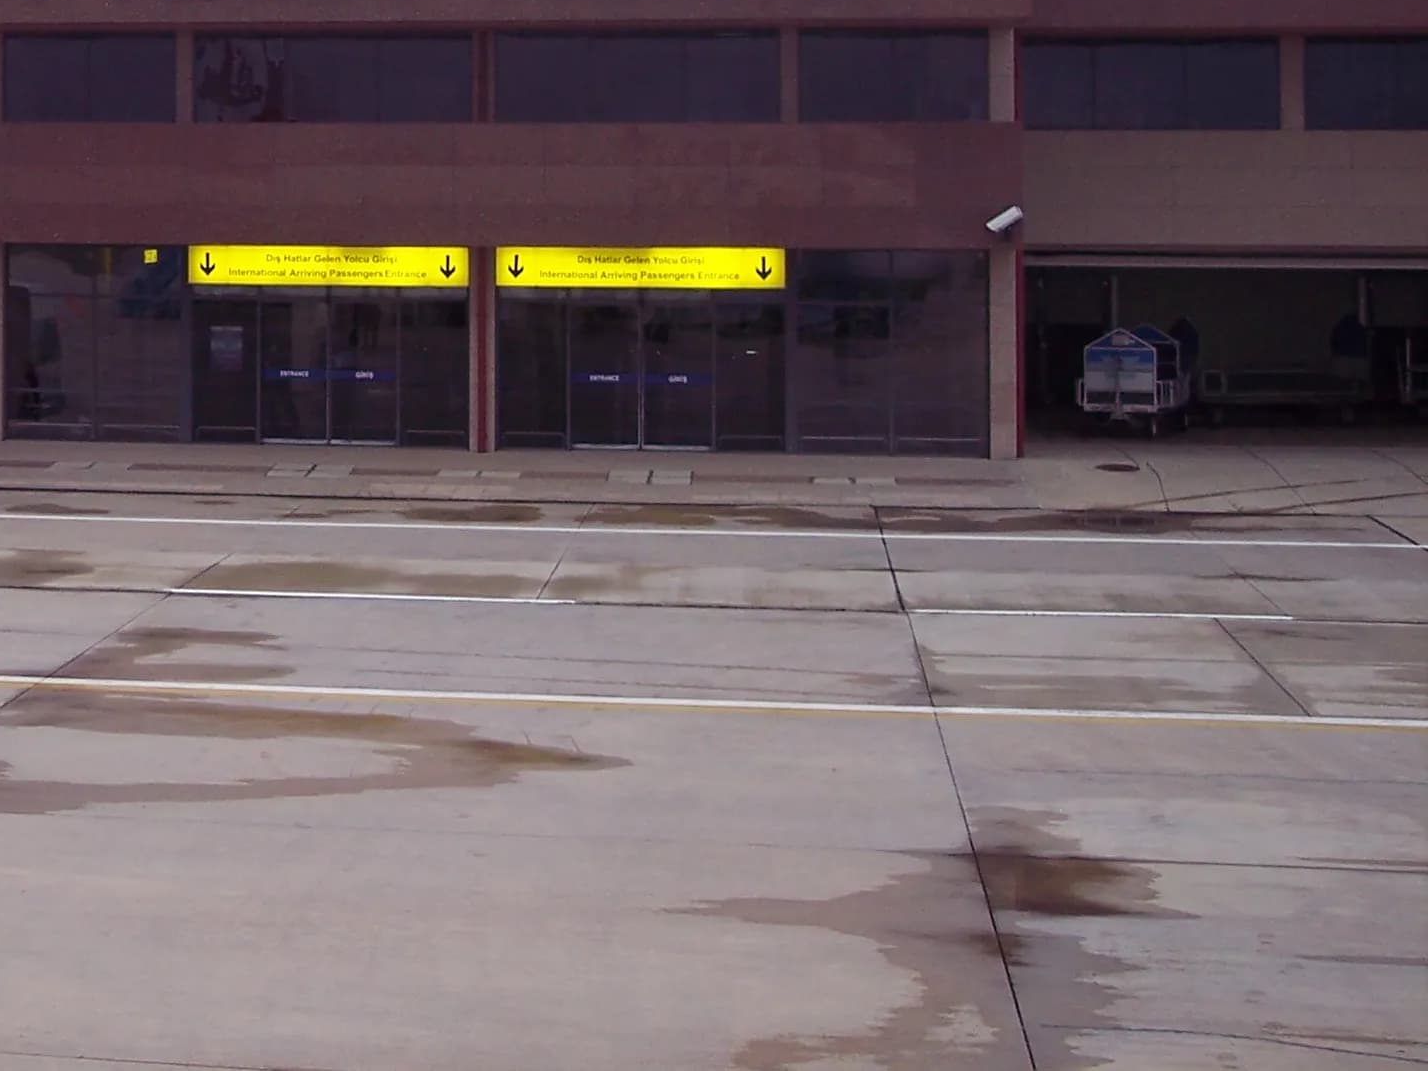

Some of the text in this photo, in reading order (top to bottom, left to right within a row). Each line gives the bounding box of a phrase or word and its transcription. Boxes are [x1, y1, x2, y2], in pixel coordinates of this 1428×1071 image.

[283, 253, 312, 263] Hatlar
[313, 254, 341, 264] Gelen
[343, 254, 370, 264] Yolcu
[594, 255, 622, 264] Hatlar
[623, 255, 651, 265] Gelen
[228, 267, 286, 277] International
[289, 268, 327, 280] Arriving
[329, 268, 383, 280] Passengers
[539, 269, 598, 279] International
[600, 270, 638, 282] Arriving
[640, 270, 695, 282] Passengers
